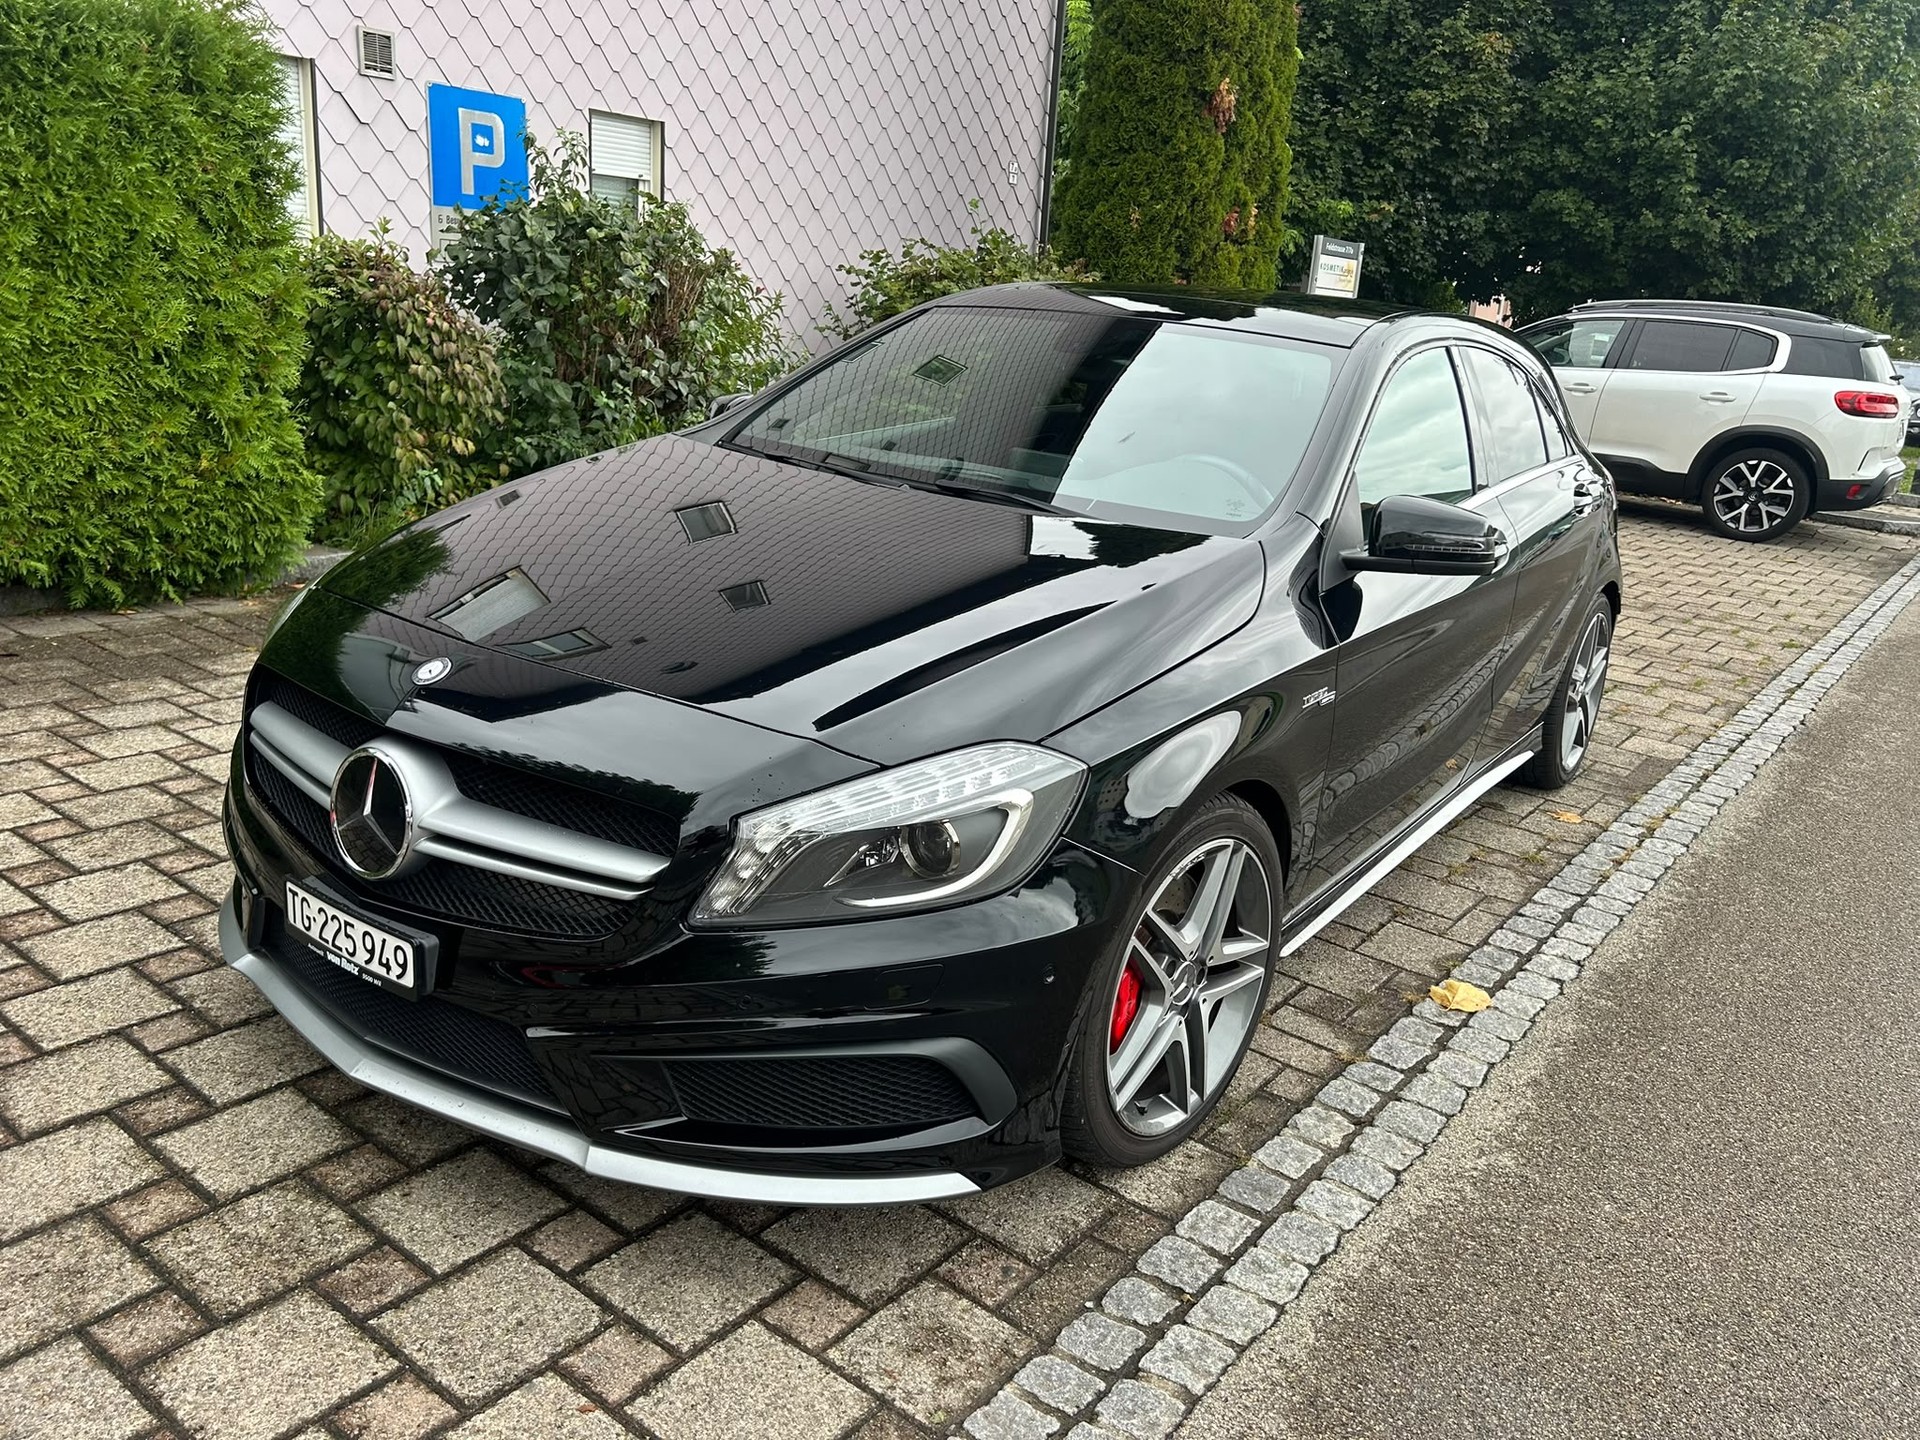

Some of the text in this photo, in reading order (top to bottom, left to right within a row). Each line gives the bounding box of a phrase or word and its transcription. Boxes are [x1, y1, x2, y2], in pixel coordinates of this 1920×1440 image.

[458, 107, 505, 195] P
[438, 214, 443, 224] 6
[326, 950, 341, 966] von
[341, 957, 360, 976] Rotz
